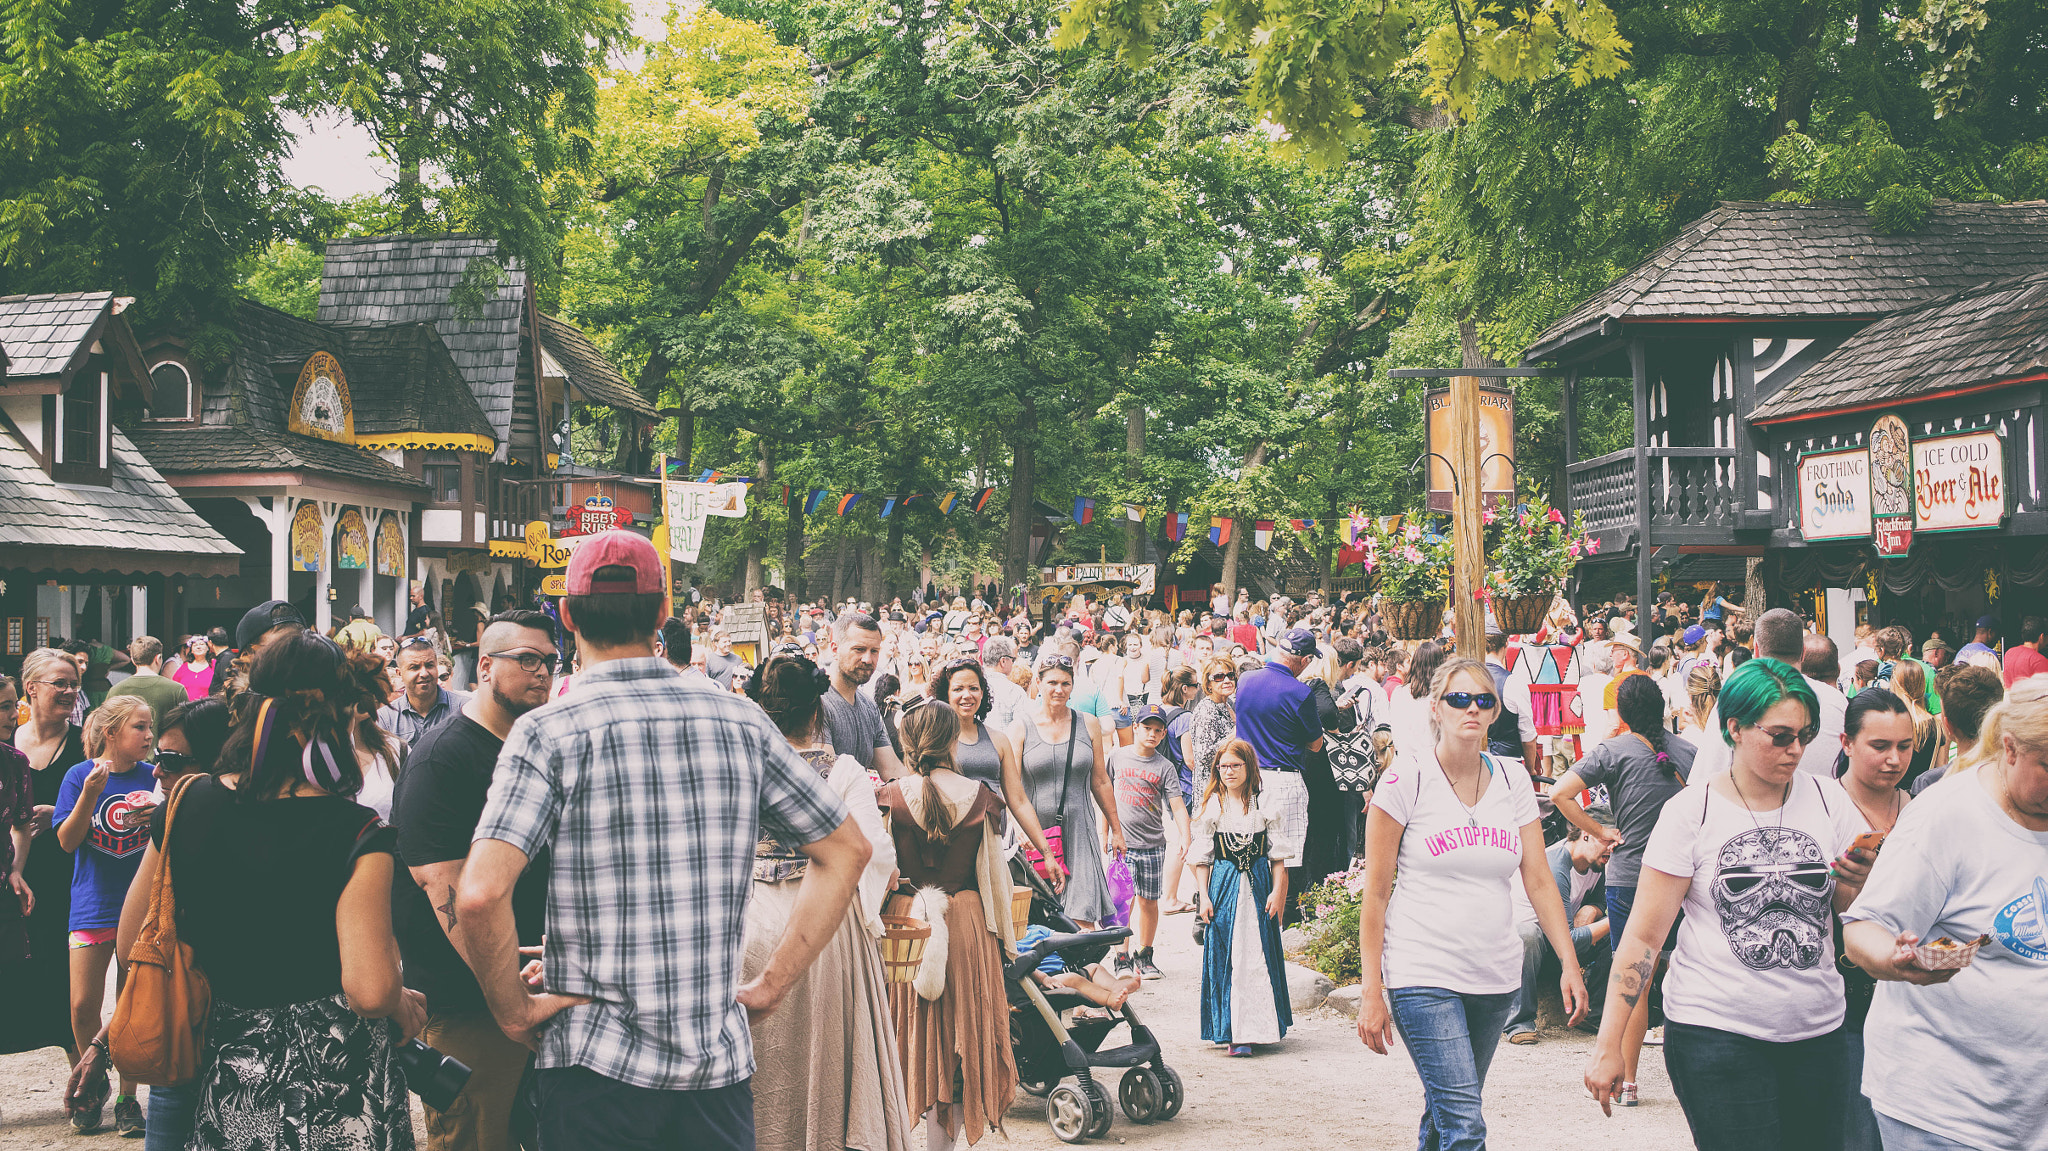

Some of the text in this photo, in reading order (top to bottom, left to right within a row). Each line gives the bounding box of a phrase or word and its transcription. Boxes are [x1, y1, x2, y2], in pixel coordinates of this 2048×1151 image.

[1925, 442, 1989, 467] ICE COLD
[1806, 459, 1863, 481] FROTHING
[1811, 480, 1856, 529] Soda
[1916, 468, 1957, 521] Beer
[1965, 464, 2000, 520] Ale
[581, 512, 618, 524] BEEF
[1875, 517, 1912, 549] Blackfriar
[1883, 531, 1901, 553] Inn
[1424, 826, 1519, 857] UNSTOPPABLE
